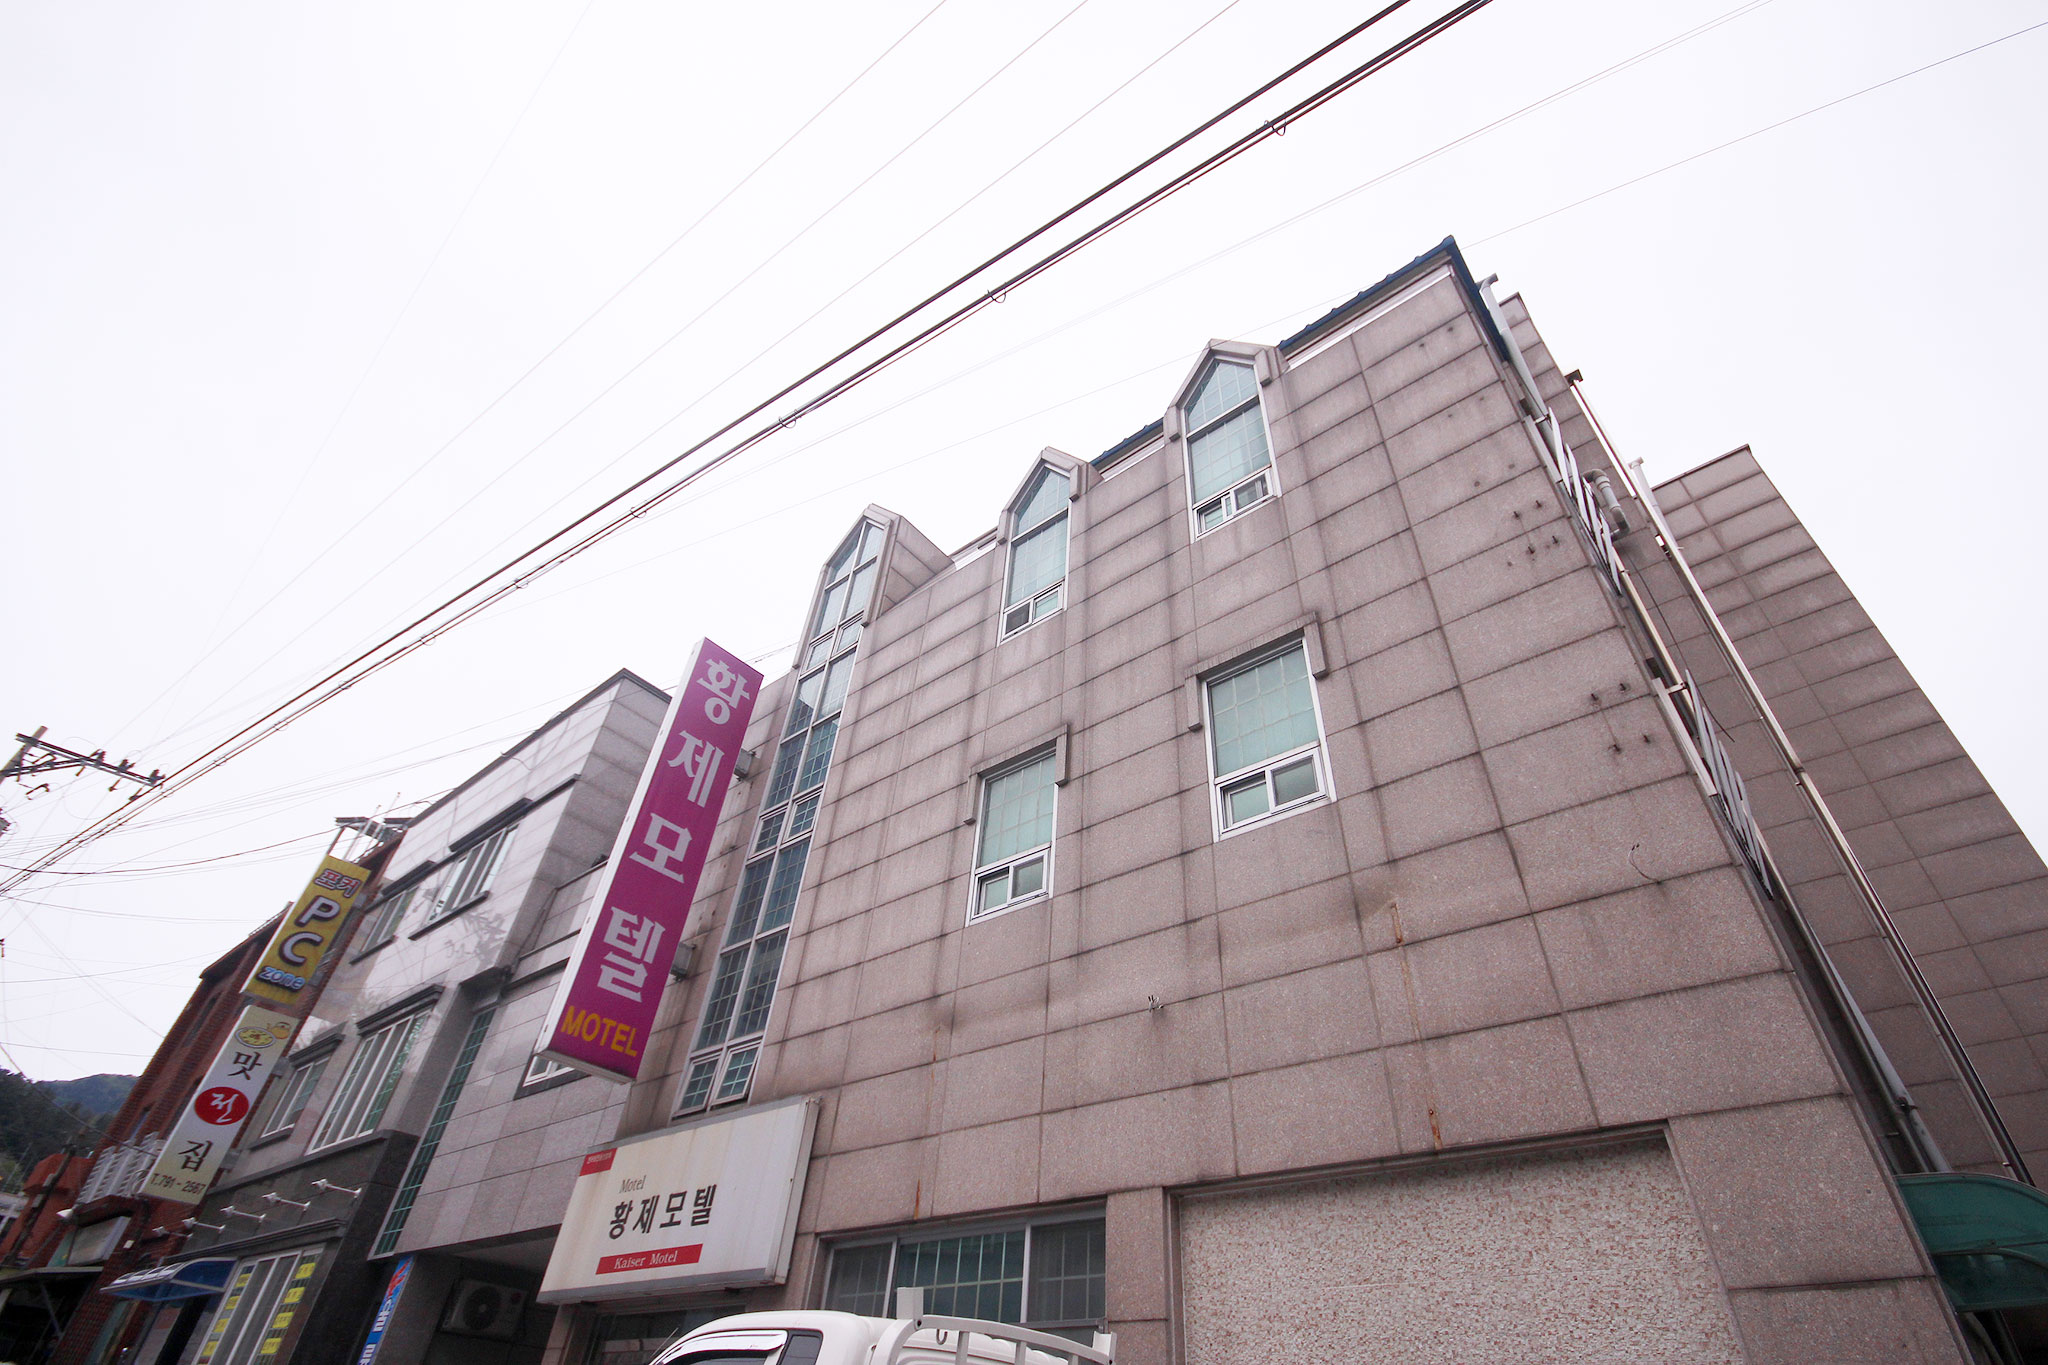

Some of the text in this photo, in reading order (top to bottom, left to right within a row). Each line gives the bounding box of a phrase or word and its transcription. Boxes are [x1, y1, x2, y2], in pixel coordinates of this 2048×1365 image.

[596, 658, 750, 1004] 황제모텔
[314, 868, 362, 899] 포커
[256, 965, 306, 992] zone
[561, 1004, 637, 1058] MOTEL
[619, 1175, 646, 1194] Motel
[609, 1184, 717, 1239] 황제모텔
[614, 1251, 678, 1269] Kaiser Motel
